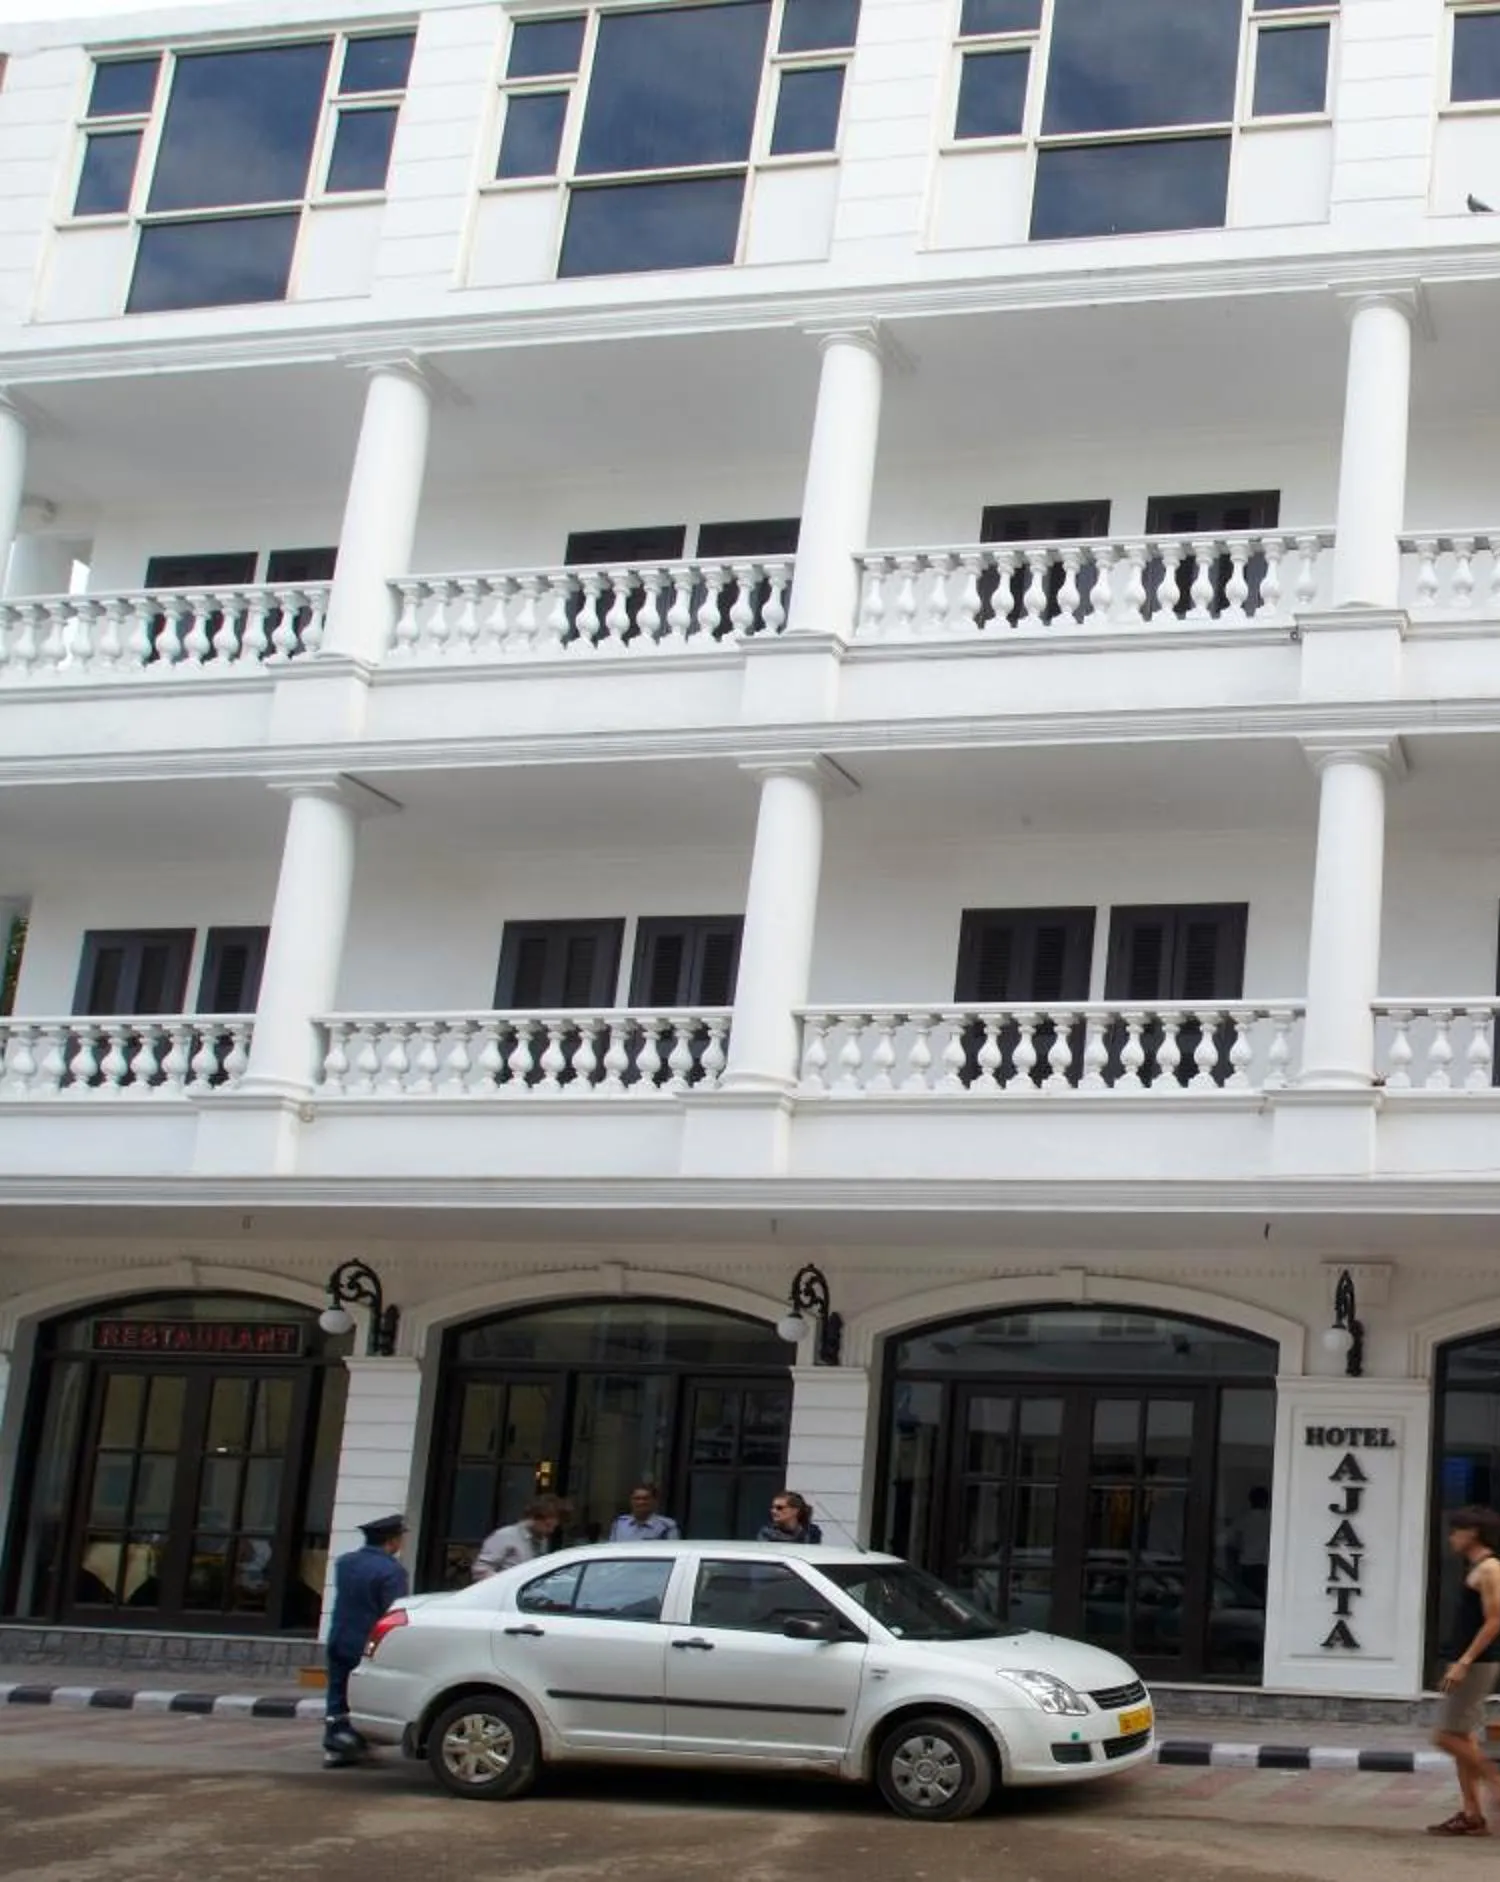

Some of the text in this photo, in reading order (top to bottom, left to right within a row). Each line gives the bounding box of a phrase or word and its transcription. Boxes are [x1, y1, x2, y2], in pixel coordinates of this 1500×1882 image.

[98, 1322, 296, 1351] RESTAURANT
[1305, 1426, 1396, 1448] HOTEL
[1320, 1452, 1369, 1650] AJANTA
